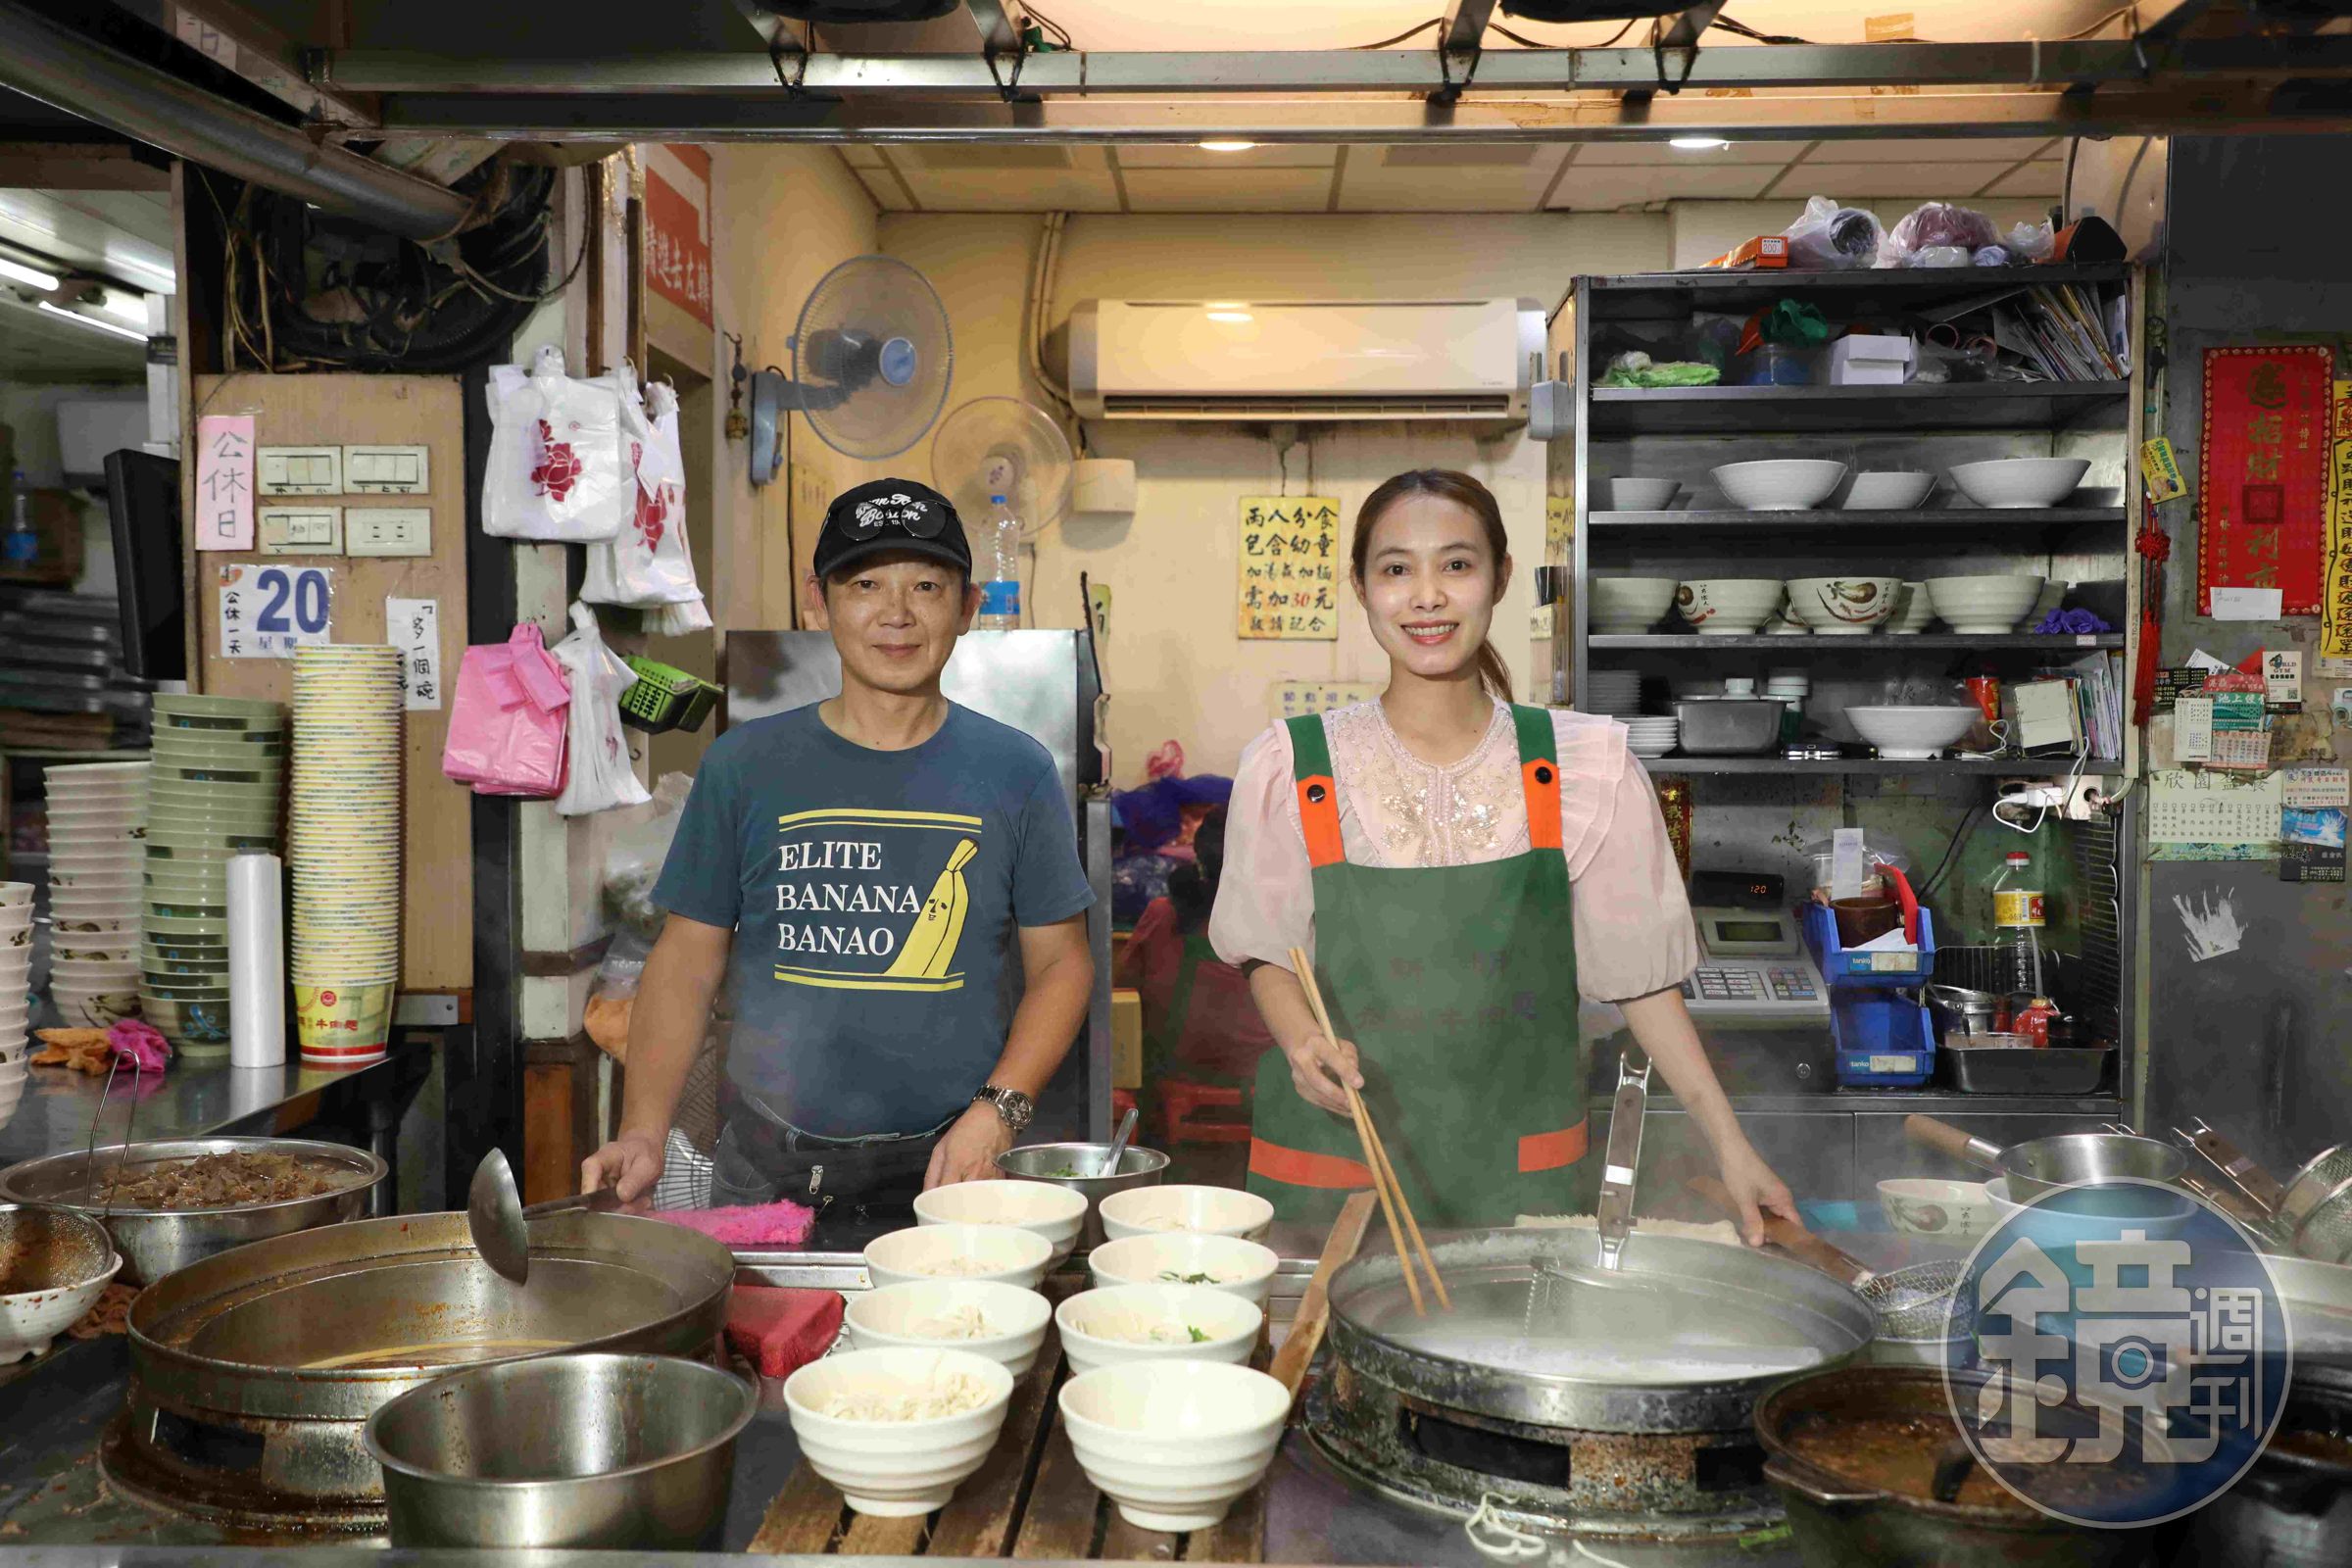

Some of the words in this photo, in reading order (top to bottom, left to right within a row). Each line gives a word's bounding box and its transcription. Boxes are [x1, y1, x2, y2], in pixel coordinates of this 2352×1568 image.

[203, 431, 248, 538] 公休日
[1245, 532, 1334, 558] 包含幼童
[256, 568, 330, 634] 20
[224, 591, 242, 655] 公休一天
[778, 841, 882, 871] ELITE
[775, 882, 921, 913] BANANA
[1750, 885, 1767, 894] 120
[777, 923, 895, 956] BANAO
